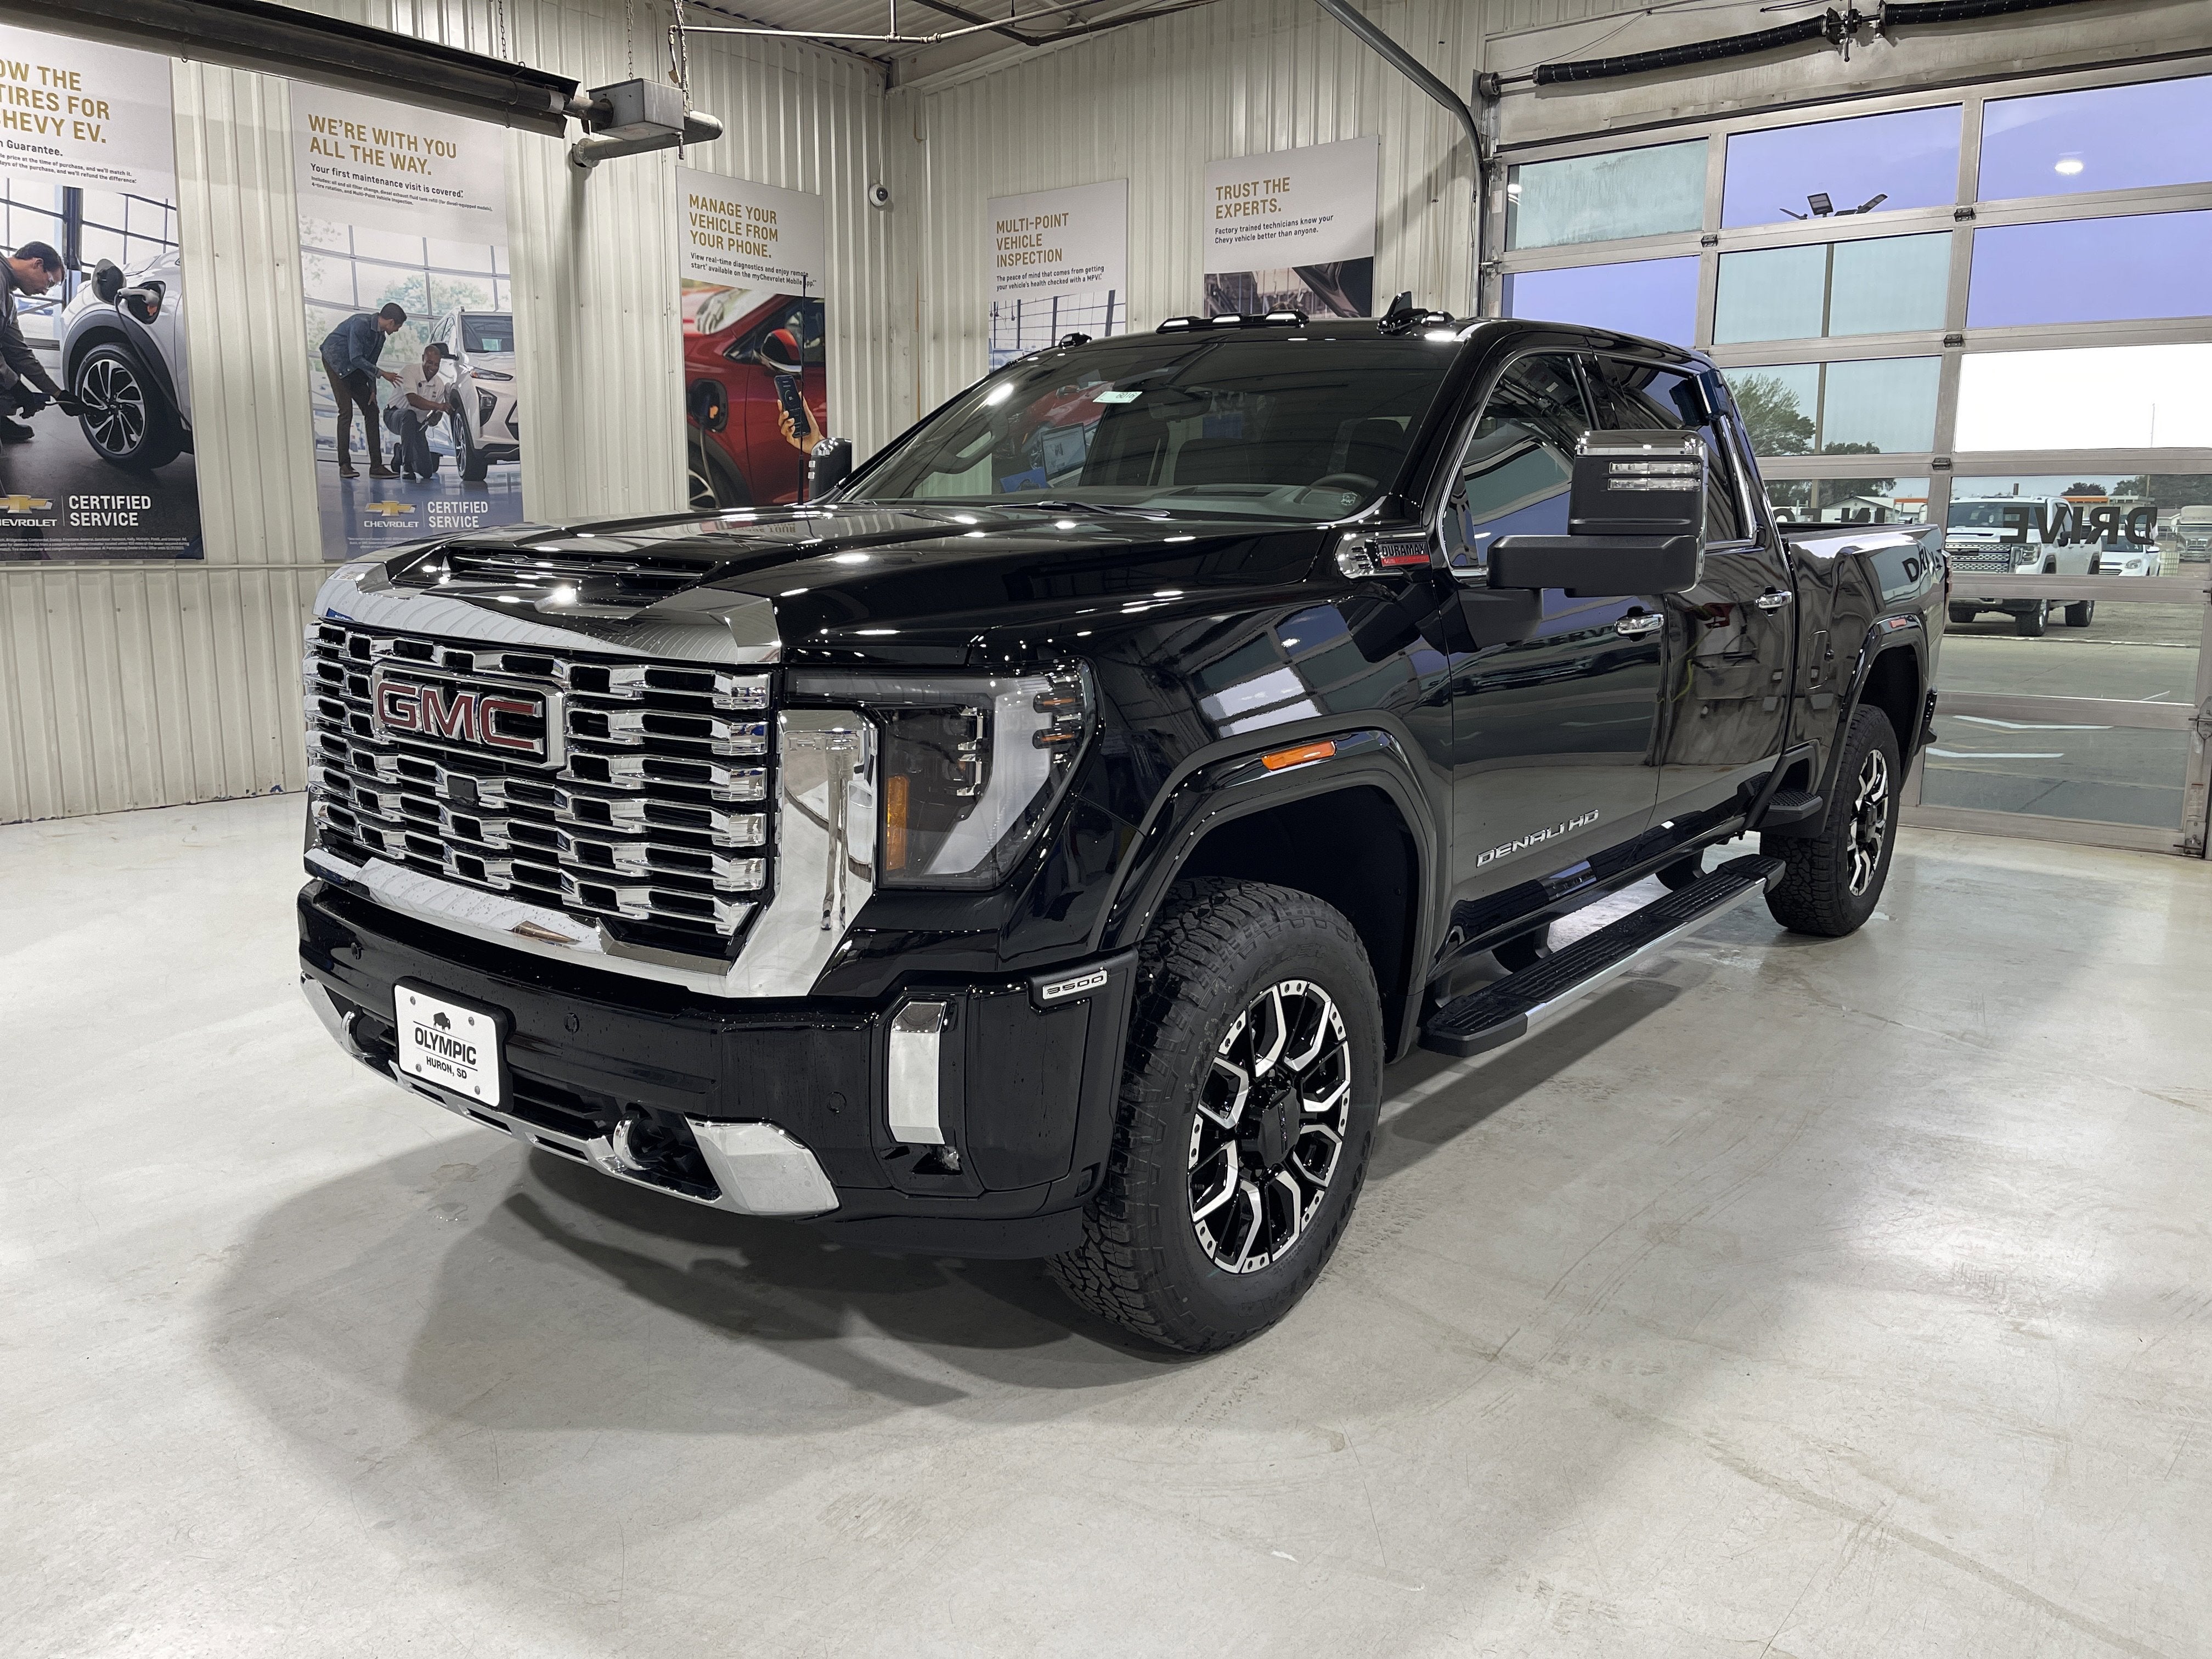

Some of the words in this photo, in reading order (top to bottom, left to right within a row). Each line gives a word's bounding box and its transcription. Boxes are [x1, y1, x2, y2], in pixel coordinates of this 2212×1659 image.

[37, 66, 82, 92] THE
[68, 96, 110, 120] FOR
[0, 108, 65, 137] HEVY
[74, 121, 106, 144] EV.
[7, 139, 63, 156] Guarantee.
[372, 127, 418, 152] WITH
[422, 137, 456, 159] YOU
[309, 137, 345, 160] ALL
[350, 144, 385, 167] THE
[390, 153, 432, 176] WAY.
[29, 165, 55, 173] purchase,
[311, 163, 329, 174] Your
[332, 167, 350, 179] first
[352, 173, 403, 188] maintenance
[405, 182, 422, 191] visit
[423, 184, 430, 193] is
[1216, 182, 1259, 201] TRUST
[1263, 177, 1290, 194] THE
[689, 194, 742, 218] MANAGE
[745, 206, 777, 224] YOUR
[1216, 198, 1282, 219] EXPERTS.
[689, 212, 742, 236] VEHICLE
[746, 224, 778, 241] FROM
[997, 212, 1069, 234] MULTI-POINT
[1215, 225, 1238, 235] Factory
[1239, 223, 1261, 233] trained
[1263, 219, 1299, 229] technicians
[1318, 215, 1334, 224] your
[690, 230, 724, 250] YOUR
[728, 238, 771, 258] PHONE.
[996, 233, 1042, 251] VEHICLE
[1215, 236, 1233, 245] Chevy
[1234, 234, 1256, 242] vehicle
[1257, 232, 1277, 240] better
[1294, 227, 1319, 236] anyone.
[691, 252, 704, 261] View
[706, 257, 732, 266] real-time
[733, 260, 764, 271] diagnostics
[776, 268, 789, 276] enjoy
[997, 248, 1062, 268] INSPECTION
[708, 266, 732, 275] available
[752, 274, 785, 283] myChevrolet
[786, 277, 802, 285] Mobile
[1085, 266, 1104, 275] getting
[996, 284, 1008, 292] your
[1008, 280, 1030, 289] vehicle's
[1047, 278, 1069, 286] checked
[69, 495, 151, 510] CERTIFIED
[427, 501, 488, 514] CERTIFIED
[0, 518, 58, 527] EVROLET
[70, 512, 139, 527] SERVICE
[428, 516, 479, 528] SERVICE
[1382, 544, 1425, 556] DURAMAX
[377, 680, 544, 755] GMC
[1476, 823, 1565, 868] DENALI
[1568, 809, 1599, 831] HD
[1047, 975, 1103, 995] 3500
[415, 1027, 477, 1065] OLYMPIC
[426, 1056, 455, 1076] HURON,
[456, 1068, 467, 1079] SD
